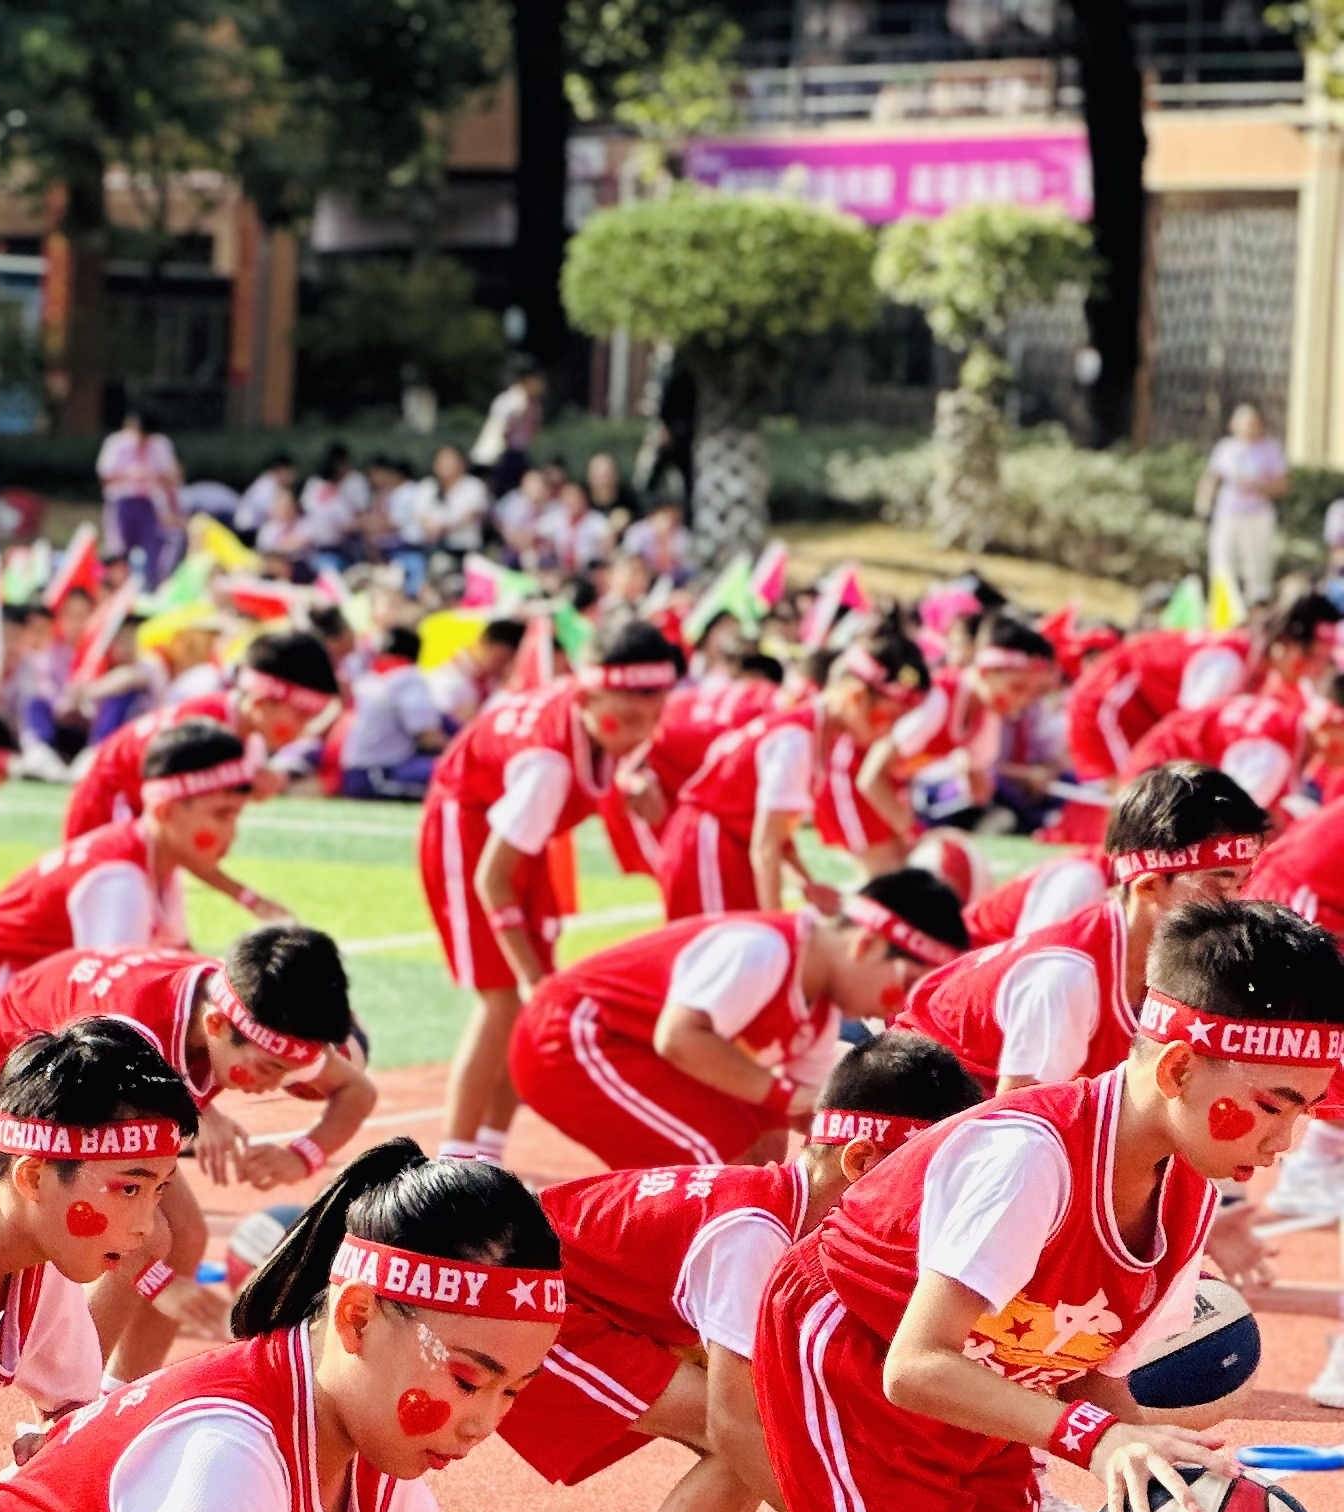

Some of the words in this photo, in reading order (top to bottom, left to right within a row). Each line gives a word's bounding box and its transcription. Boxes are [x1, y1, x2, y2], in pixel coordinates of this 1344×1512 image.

[1221, 1023, 1322, 1060] CHINA
[4, 1120, 73, 1154] CHINA
[79, 1125, 159, 1154] BABY
[827, 1113, 892, 1143] BABY
[384, 1256, 489, 1307] BABY
